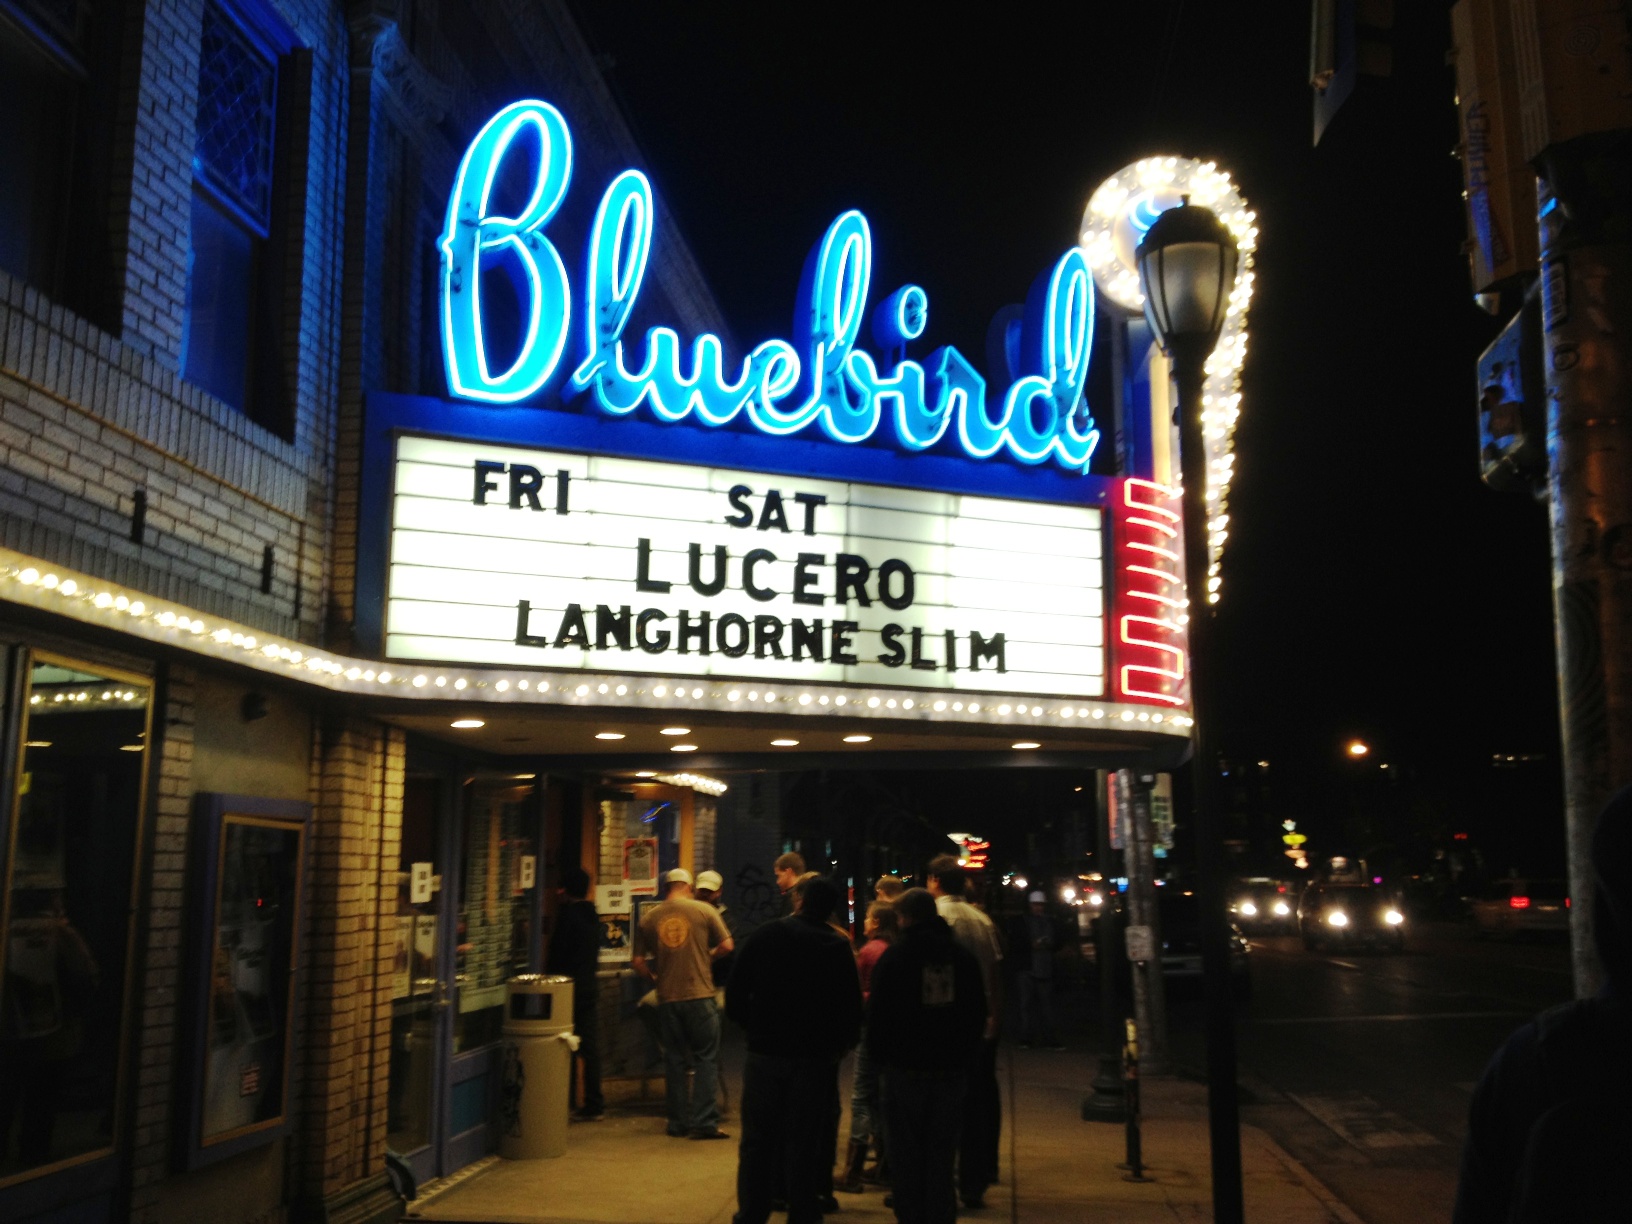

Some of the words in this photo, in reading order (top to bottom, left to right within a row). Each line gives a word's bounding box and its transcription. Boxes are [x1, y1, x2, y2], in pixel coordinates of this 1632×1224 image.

[437, 99, 1100, 471] Bluebird
[474, 459, 571, 515] FRI
[724, 484, 826, 535] SAT
[636, 537, 915, 611] LUCERO
[515, 599, 859, 666] LANGHORNE
[878, 623, 1007, 674] SLIM
